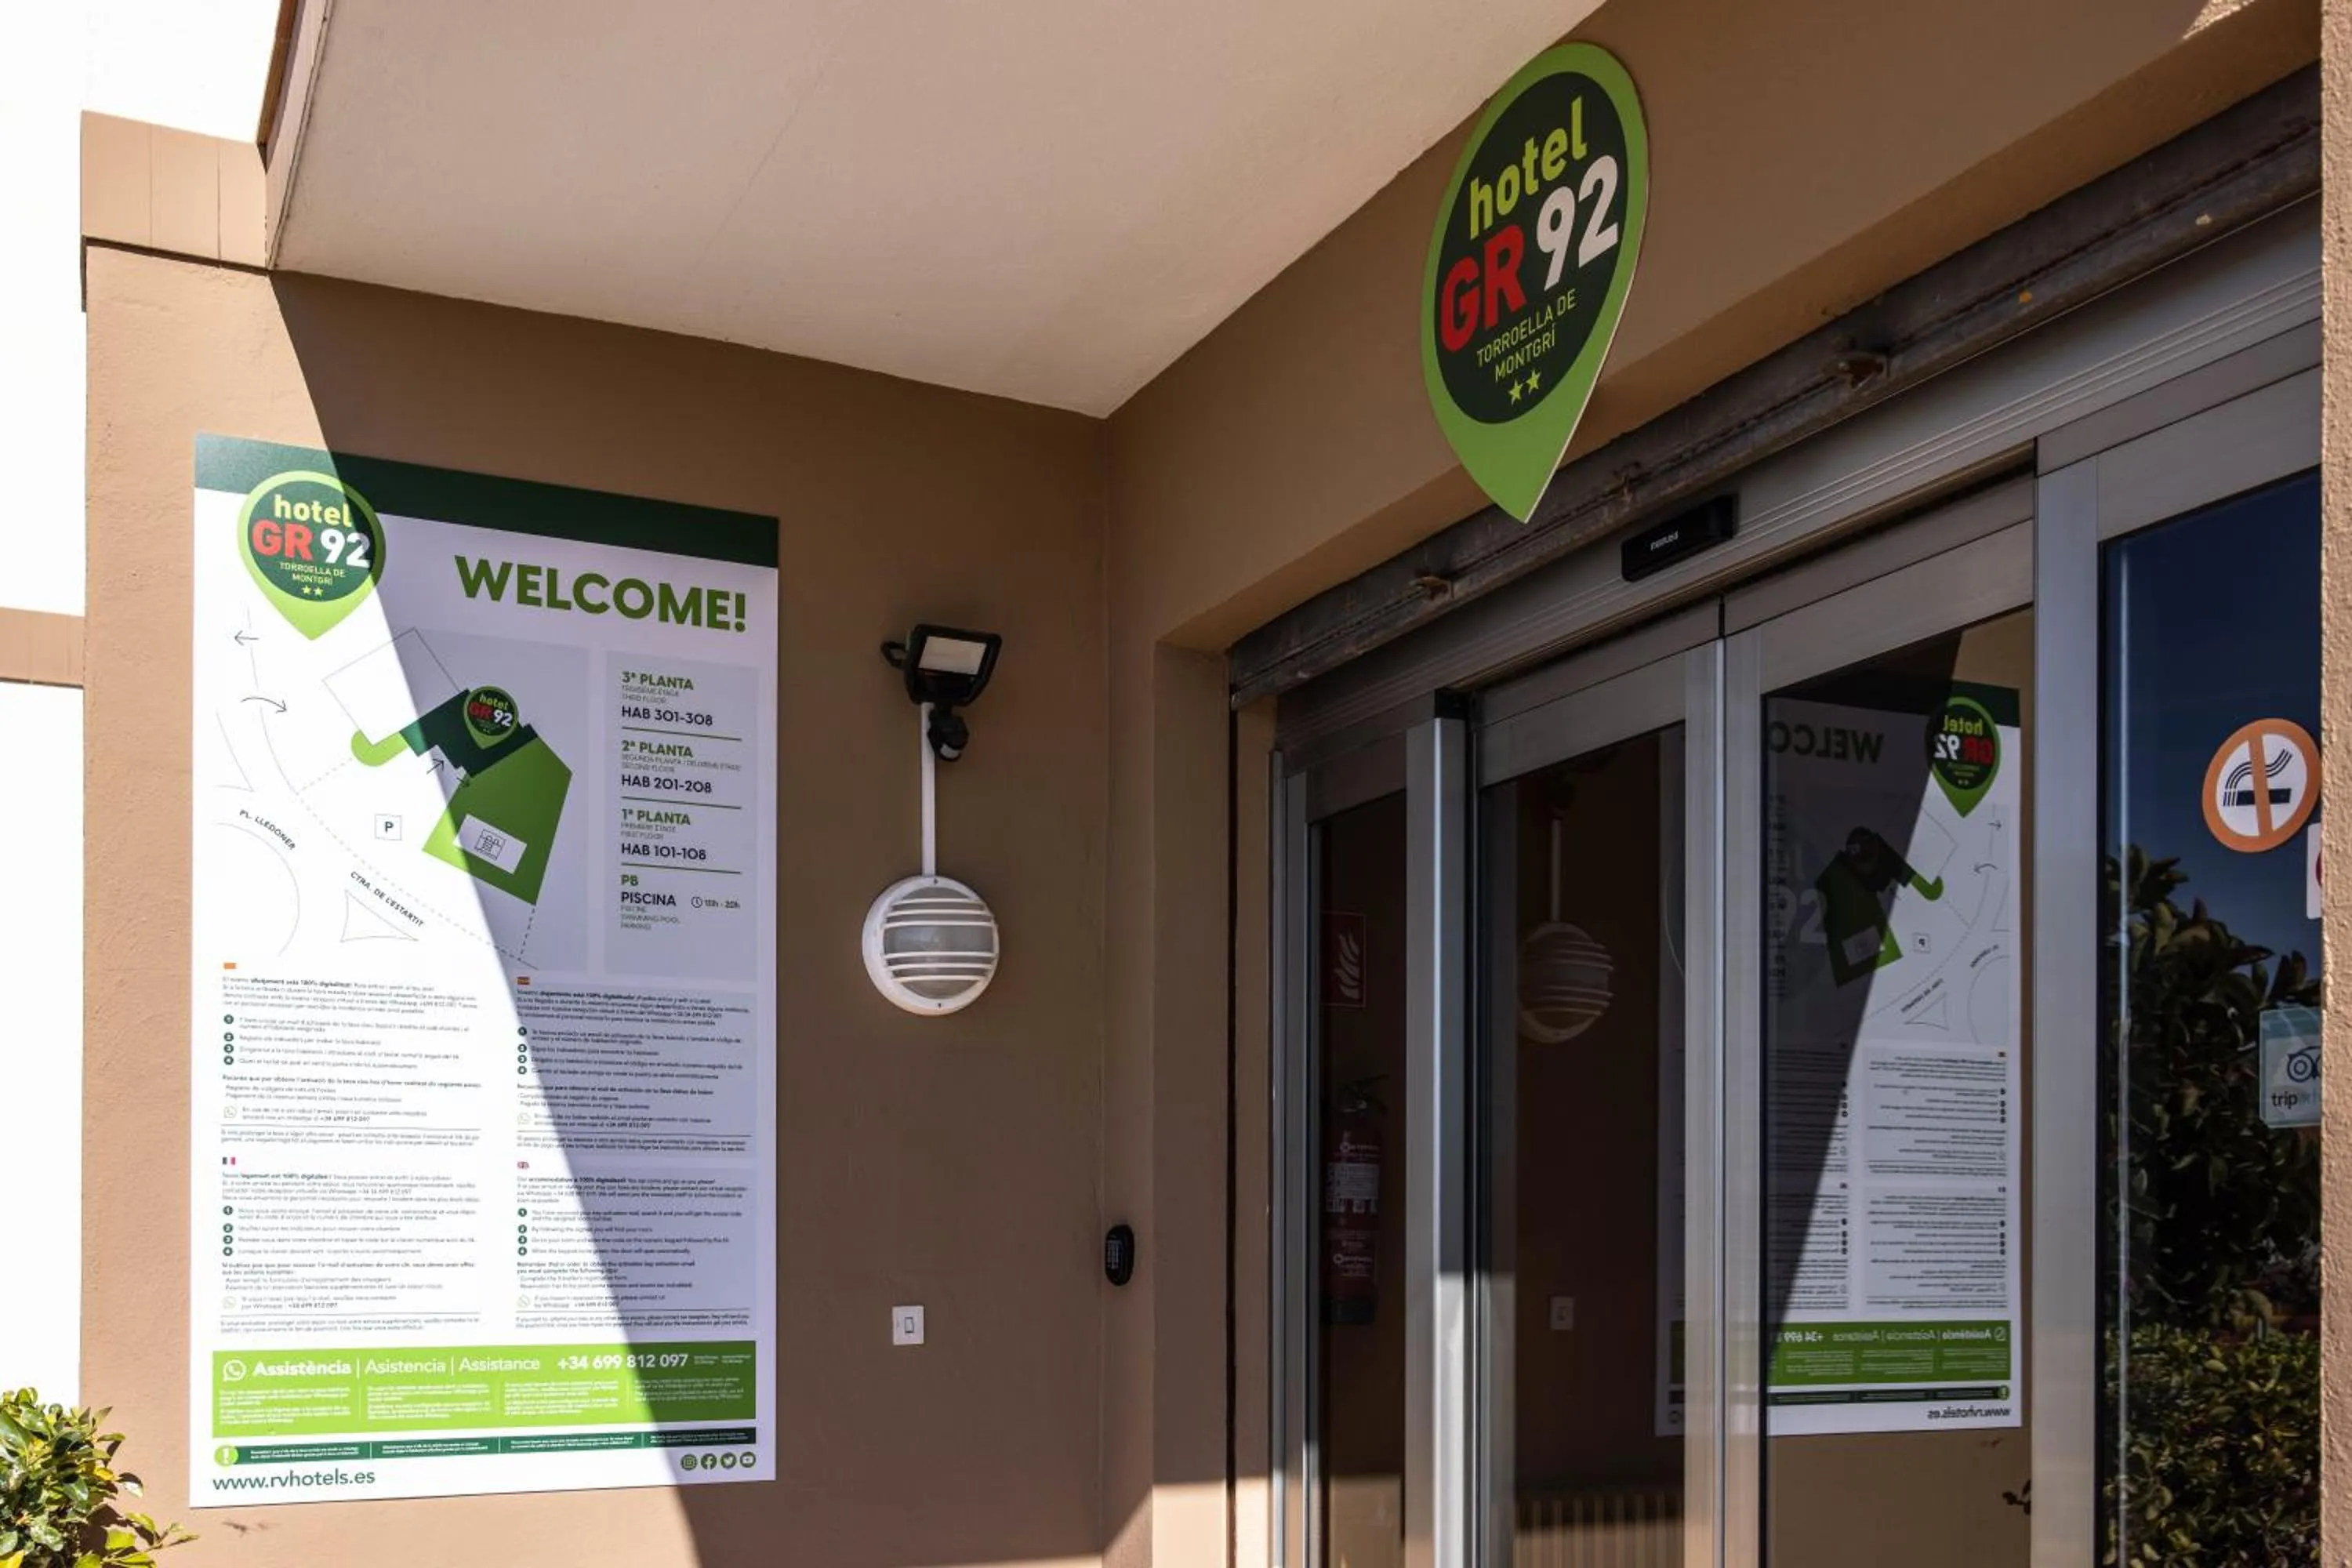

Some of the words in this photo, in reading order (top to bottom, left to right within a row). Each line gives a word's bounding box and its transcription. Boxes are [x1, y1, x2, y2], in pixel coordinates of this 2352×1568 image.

[1469, 96, 1588, 241] hotel
[1440, 224, 1527, 354] GR
[1537, 154, 1618, 292] 92
[1476, 306, 1554, 368] TORROELLA
[1555, 289, 1577, 315] DE
[1494, 323, 1556, 383] MONTGRÍ
[275, 494, 352, 528] hotel
[252, 520, 314, 561] GR
[320, 528, 371, 568] 92
[280, 562, 332, 575] TORROELLA
[333, 568, 346, 578] DE
[455, 554, 746, 633] WELCOME!
[640, 673, 694, 690] PLANTA
[494, 710, 513, 727] 92
[622, 706, 651, 719] HAB
[655, 710, 713, 727] 301-308
[640, 742, 694, 757] PLANTA
[622, 775, 650, 788] HAB
[654, 777, 712, 793] 201-208
[384, 821, 394, 833] P
[637, 810, 691, 826] PLANTA
[622, 843, 650, 856] HAB
[655, 846, 706, 860] 101-108
[621, 874, 639, 886] PB
[621, 891, 677, 906] PISCINA
[252, 1359, 353, 1377] Assistència
[365, 1358, 447, 1374] Asistencia
[459, 1357, 541, 1372] Assistance
[557, 1356, 589, 1370] +34
[592, 1355, 623, 1370] 699
[626, 1354, 655, 1369] 812
[659, 1353, 689, 1368] 097
[212, 1468, 376, 1490] www.rvhotels.es
